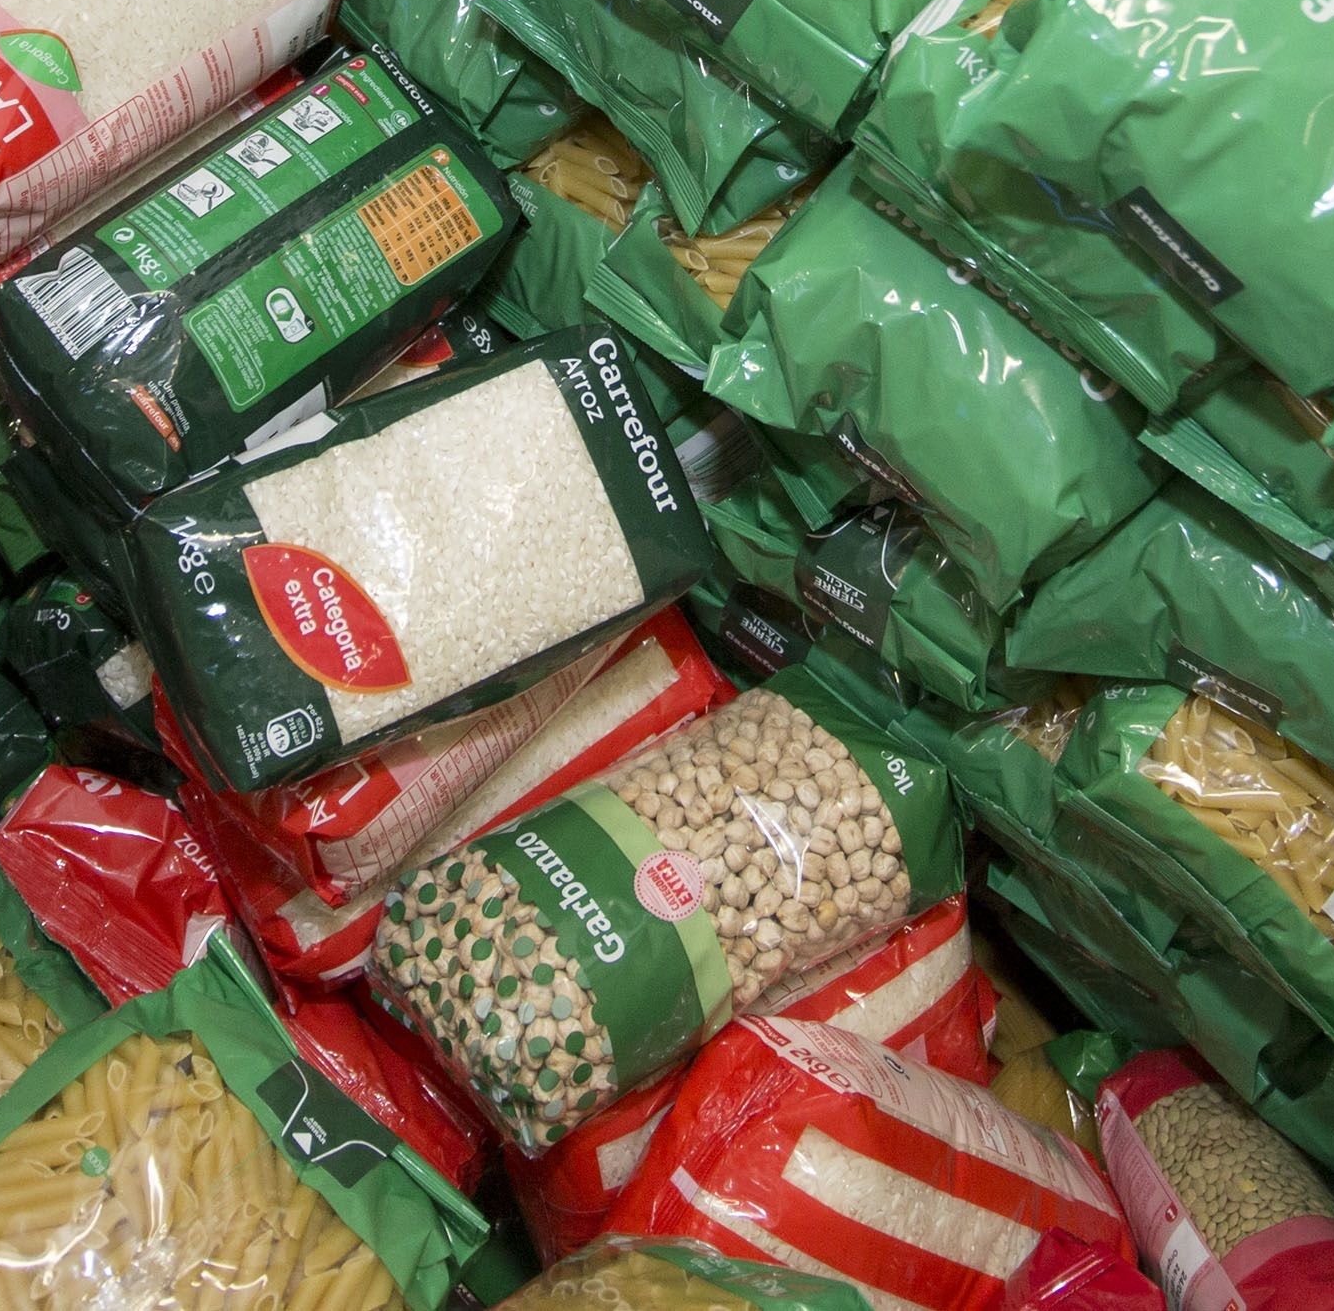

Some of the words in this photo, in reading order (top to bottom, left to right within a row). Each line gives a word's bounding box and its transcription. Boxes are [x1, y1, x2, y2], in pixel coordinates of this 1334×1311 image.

[357, 68, 394, 110] Ingredientes
[441, 164, 470, 200] Nutrición
[1132, 204, 1220, 294] Carrefour
[156, 377, 178, 399] ¿Una
[169, 397, 193, 434] pregunta,
[560, 357, 606, 426] Arroz
[587, 337, 679, 514] Carrefour
[283, 579, 318, 636] extra
[311, 567, 364, 673] Categoría
[812, 575, 866, 609] CIERRE
[739, 616, 784, 654] CIERRE
[1177, 658, 1271, 714] Carrefour
[270, 726, 288, 750] 11%
[514, 830, 627, 965] Garbanzo
[656, 858, 693, 905] EXTRA
[300, 1116, 327, 1145] CERRAR
